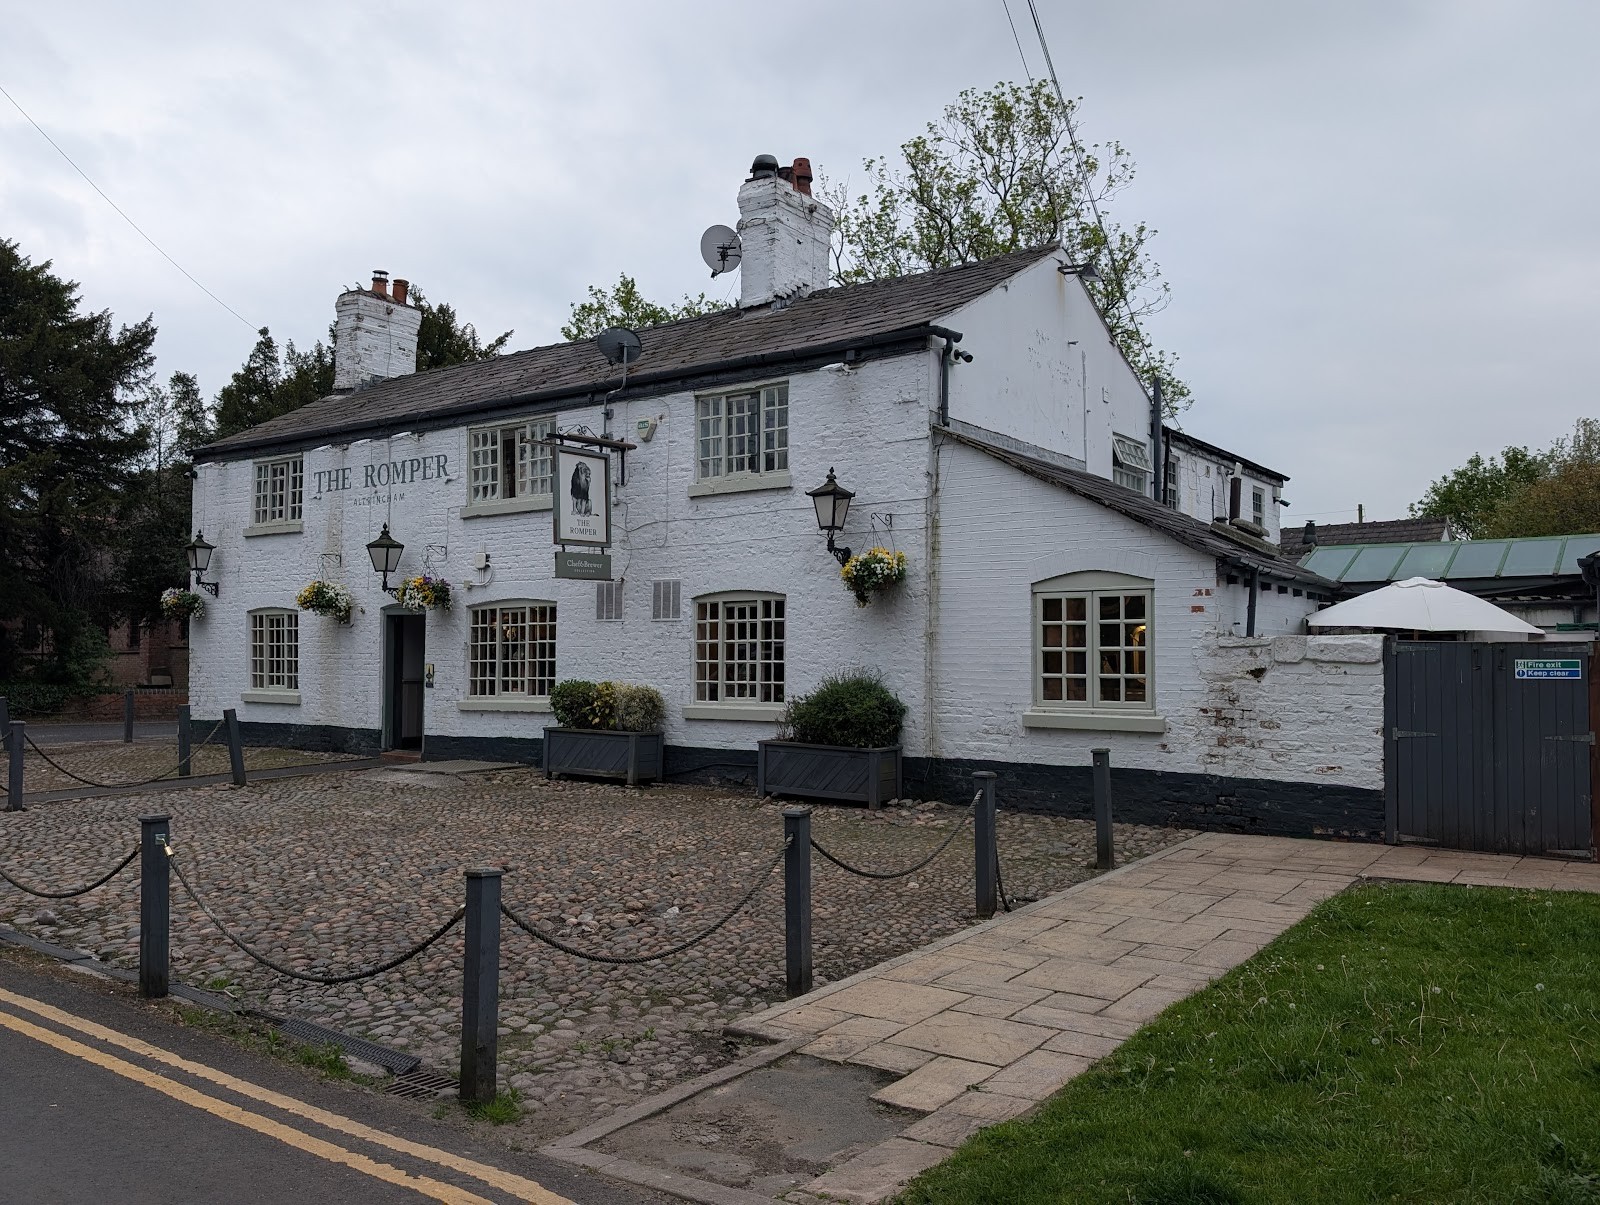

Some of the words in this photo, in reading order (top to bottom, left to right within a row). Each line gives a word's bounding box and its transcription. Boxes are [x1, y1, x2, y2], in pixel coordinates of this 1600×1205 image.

[313, 467, 352, 493] THE
[363, 454, 450, 488] ROMPER
[576, 519, 590, 527] THE
[570, 527, 597, 536] ROMPER
